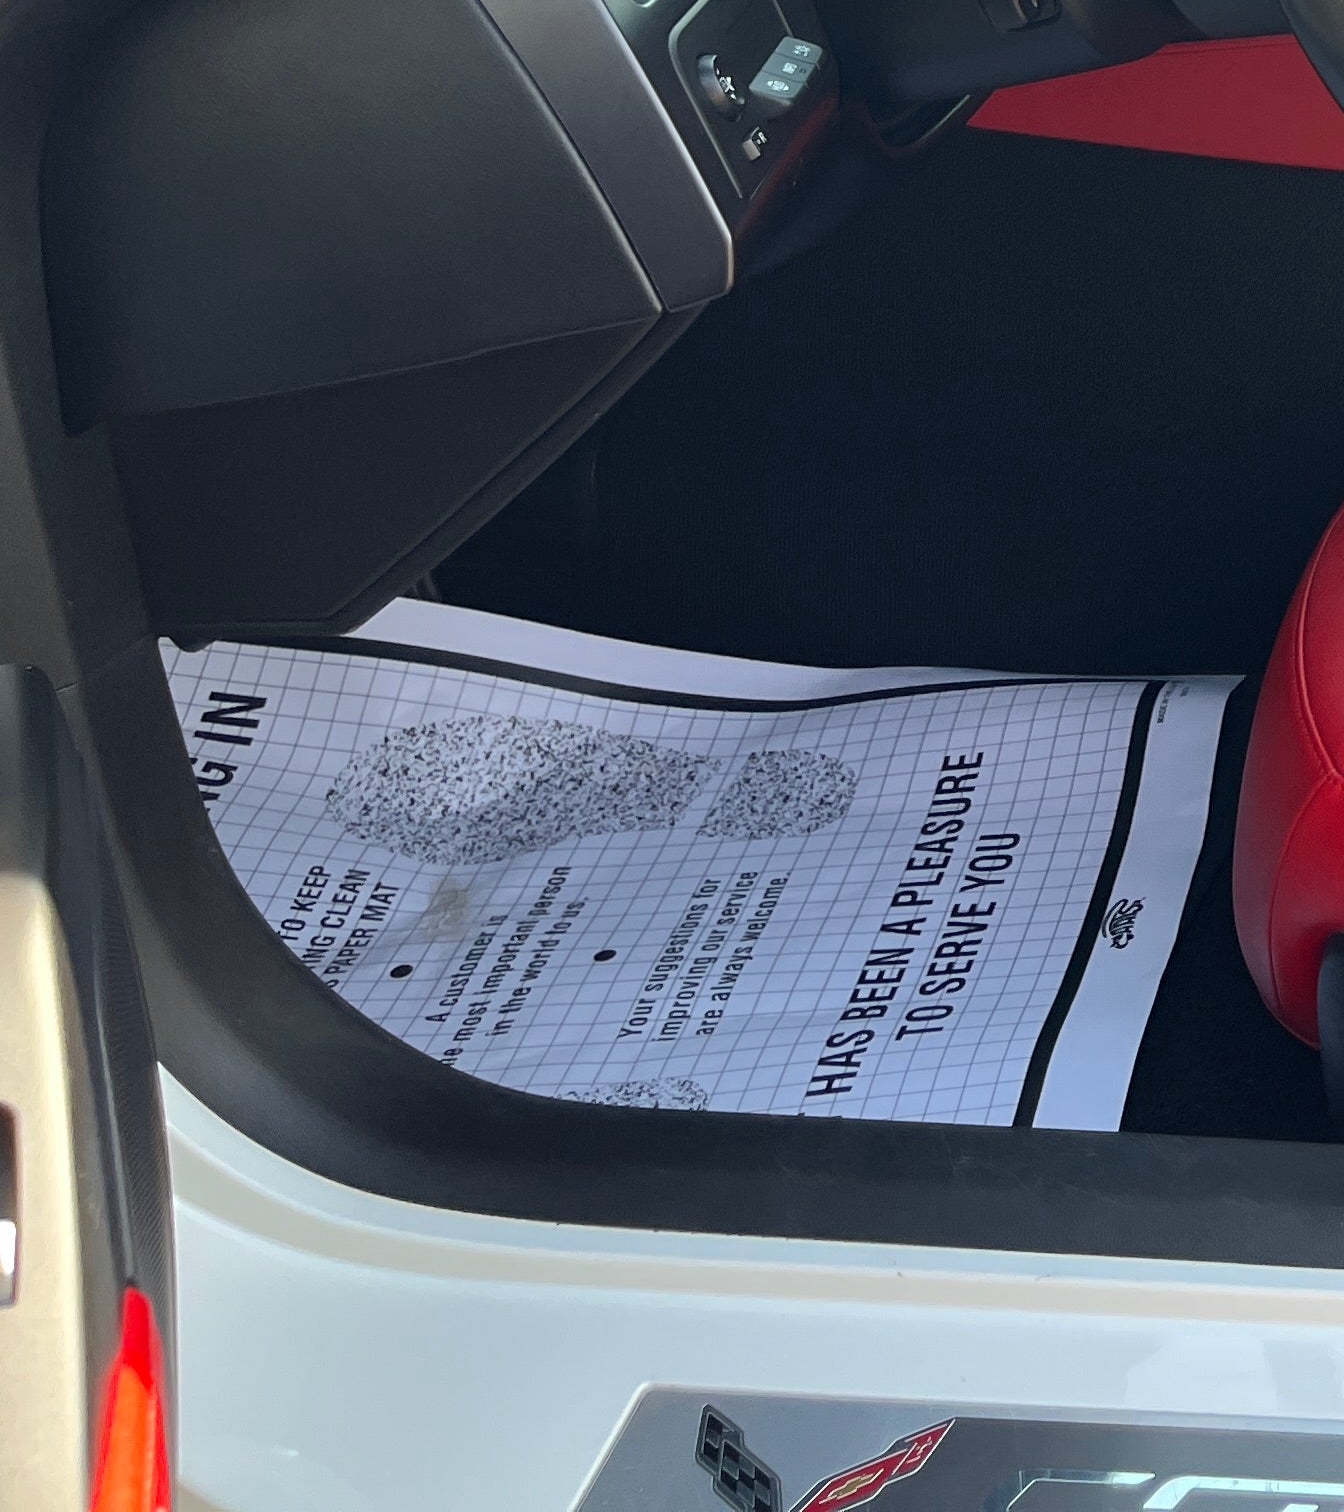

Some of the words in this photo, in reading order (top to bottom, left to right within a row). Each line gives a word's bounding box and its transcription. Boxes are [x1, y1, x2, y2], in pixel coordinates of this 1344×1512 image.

[192, 691, 268, 746] IN
[889, 751, 985, 909] PLEASURE
[290, 865, 332, 912] KEEP
[960, 832, 1022, 893] YOU
[320, 868, 371, 929] CLEAN
[323, 927, 379, 974] PAPER
[359, 881, 400, 921] MAT
[543, 921, 573, 935] to
[740, 871, 792, 943] welcome.
[879, 916, 927, 937] A
[425, 1011, 450, 1023] A
[439, 931, 497, 1007] customer
[481, 914, 509, 927] is
[452, 1000, 492, 1042] most
[473, 919, 540, 995] important
[527, 866, 572, 917] person
[519, 939, 561, 983] world
[615, 997, 657, 1039] Your
[644, 903, 709, 992] suggestions
[691, 878, 722, 899] for
[651, 956, 718, 1042] improving
[701, 928, 729, 952] our
[716, 871, 759, 926] service
[709, 946, 753, 1002] always
[918, 900, 998, 996] SERVE
[497, 987, 532, 1015] the
[839, 946, 916, 1021] BEEN
[484, 1018, 515, 1037] in
[695, 1008, 724, 1036] are
[895, 1003, 954, 1041] TO
[804, 1028, 876, 1098] HAS
